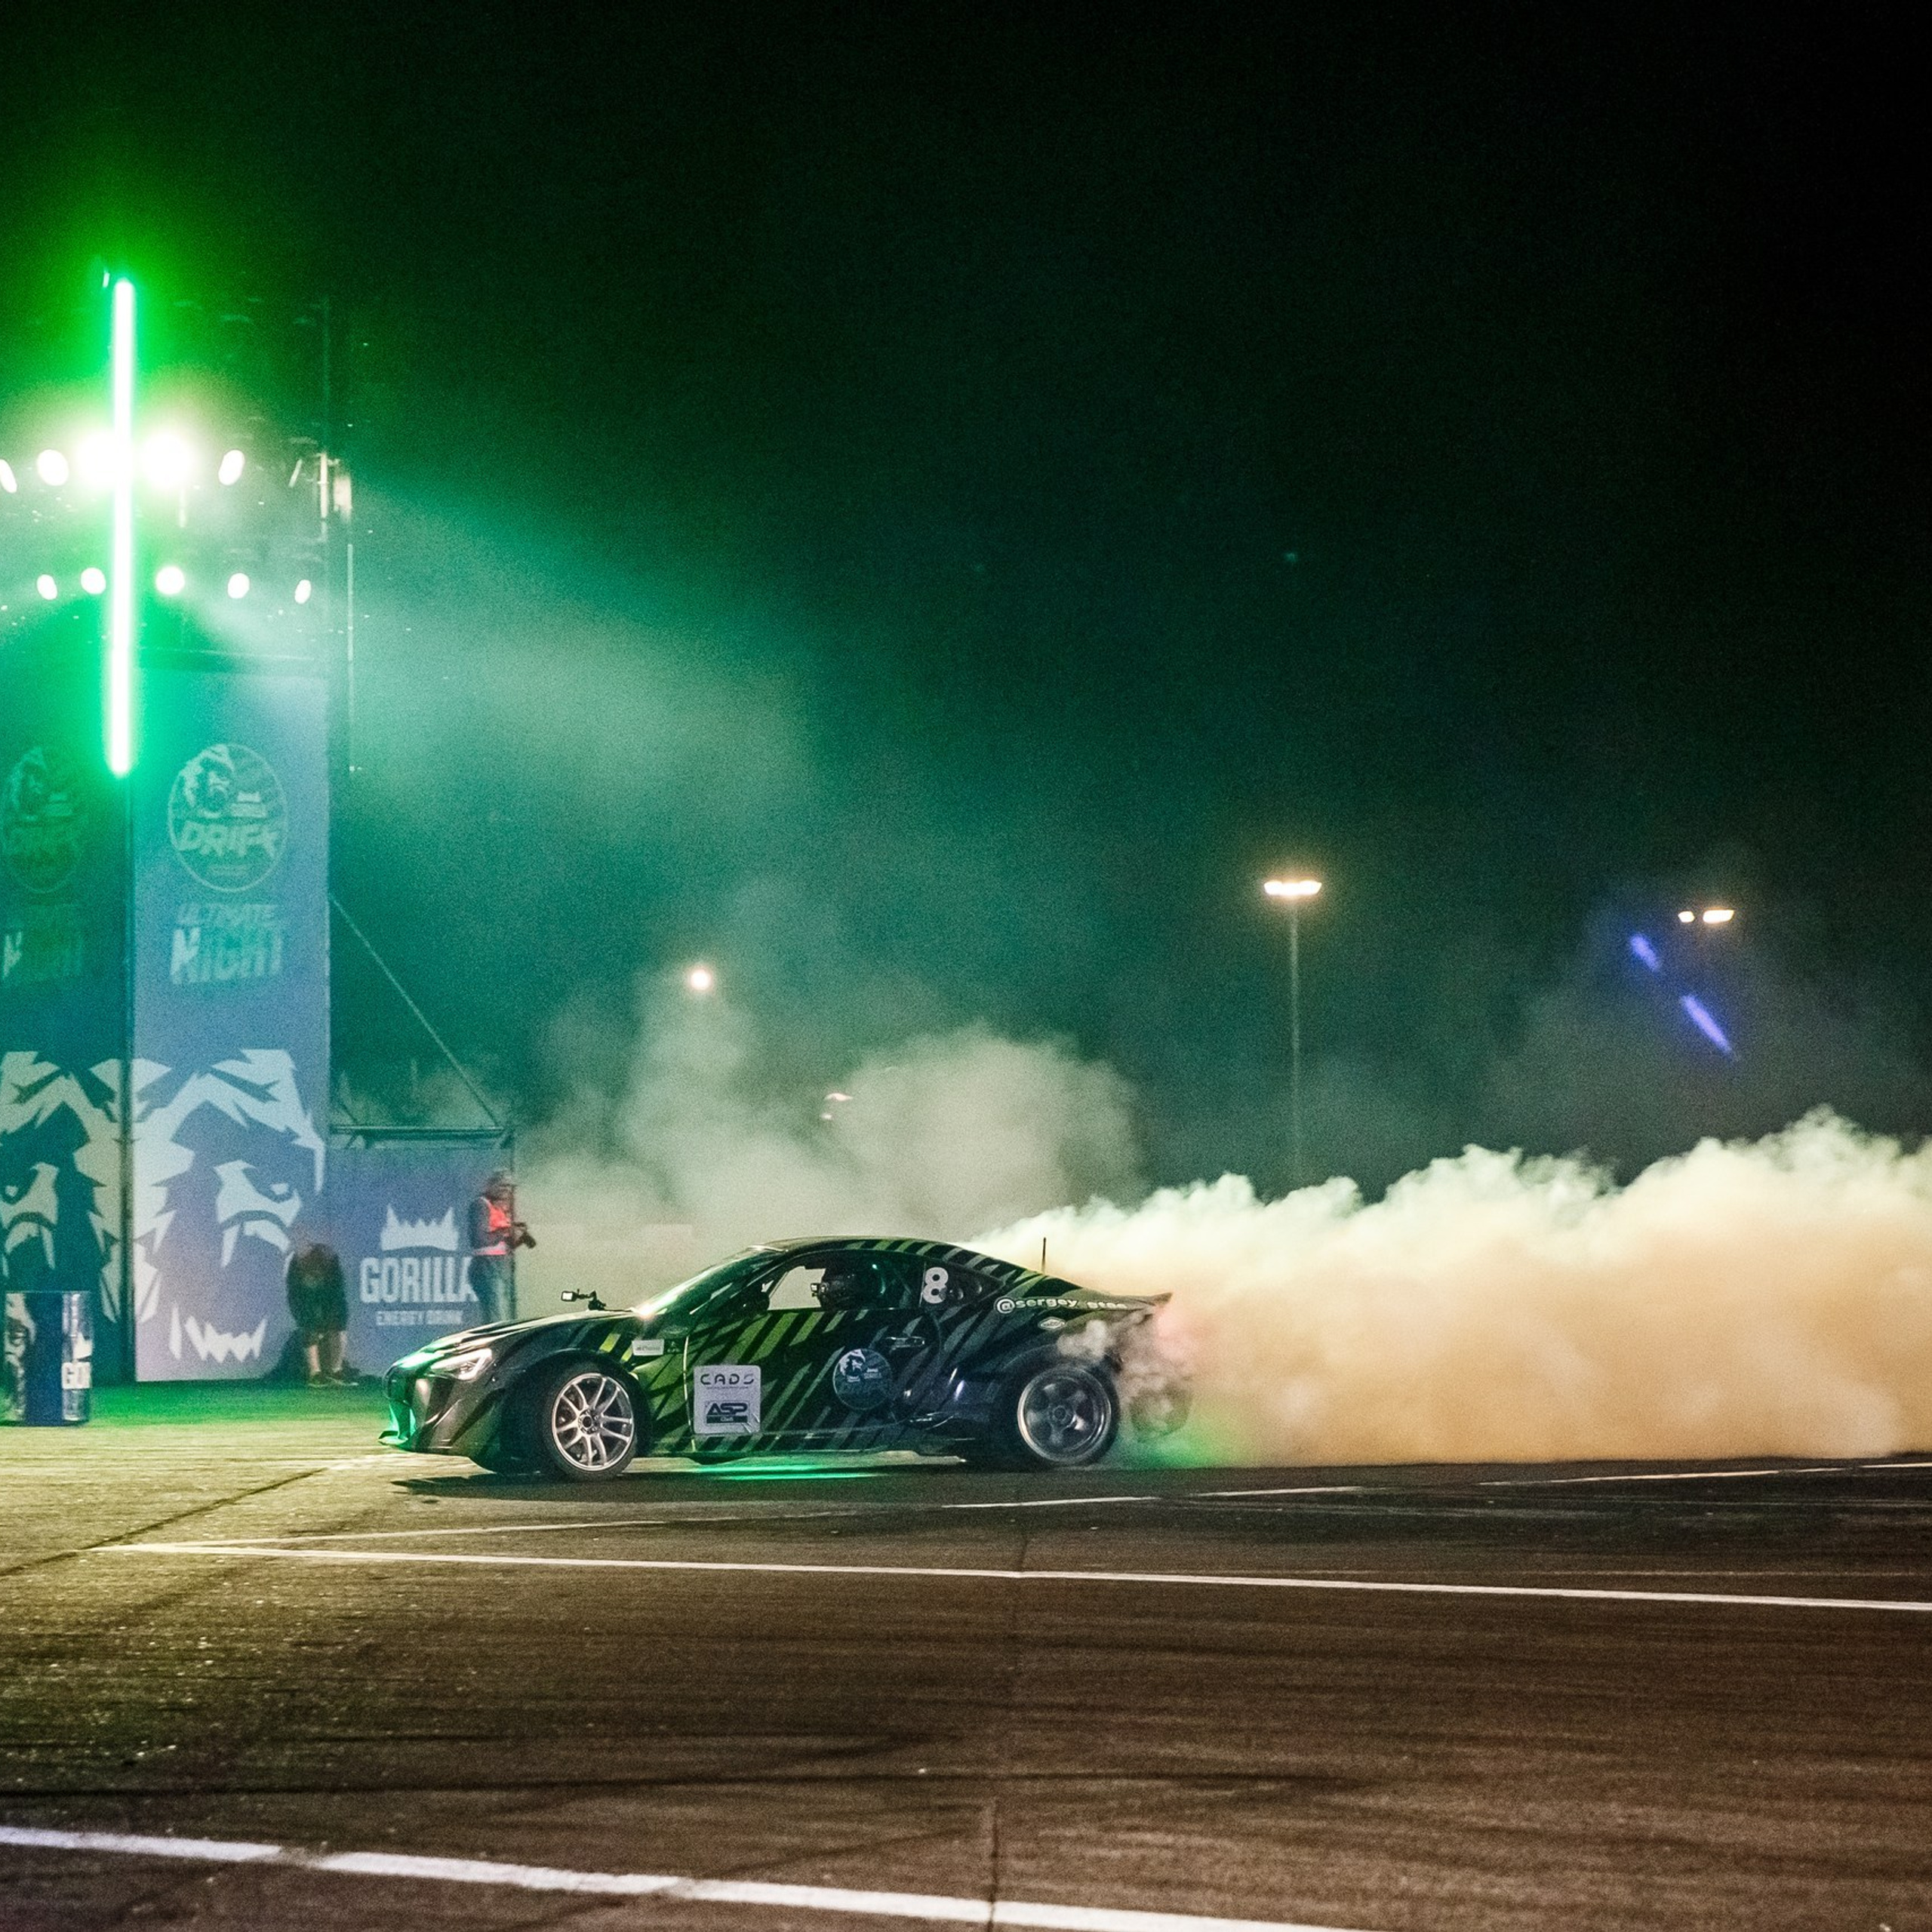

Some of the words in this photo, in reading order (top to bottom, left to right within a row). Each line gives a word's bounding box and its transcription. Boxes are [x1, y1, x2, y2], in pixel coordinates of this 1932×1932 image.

[922, 1266, 949, 1304] 8
[700, 1374, 754, 1385] CADS
[706, 1403, 748, 1416] ASP
